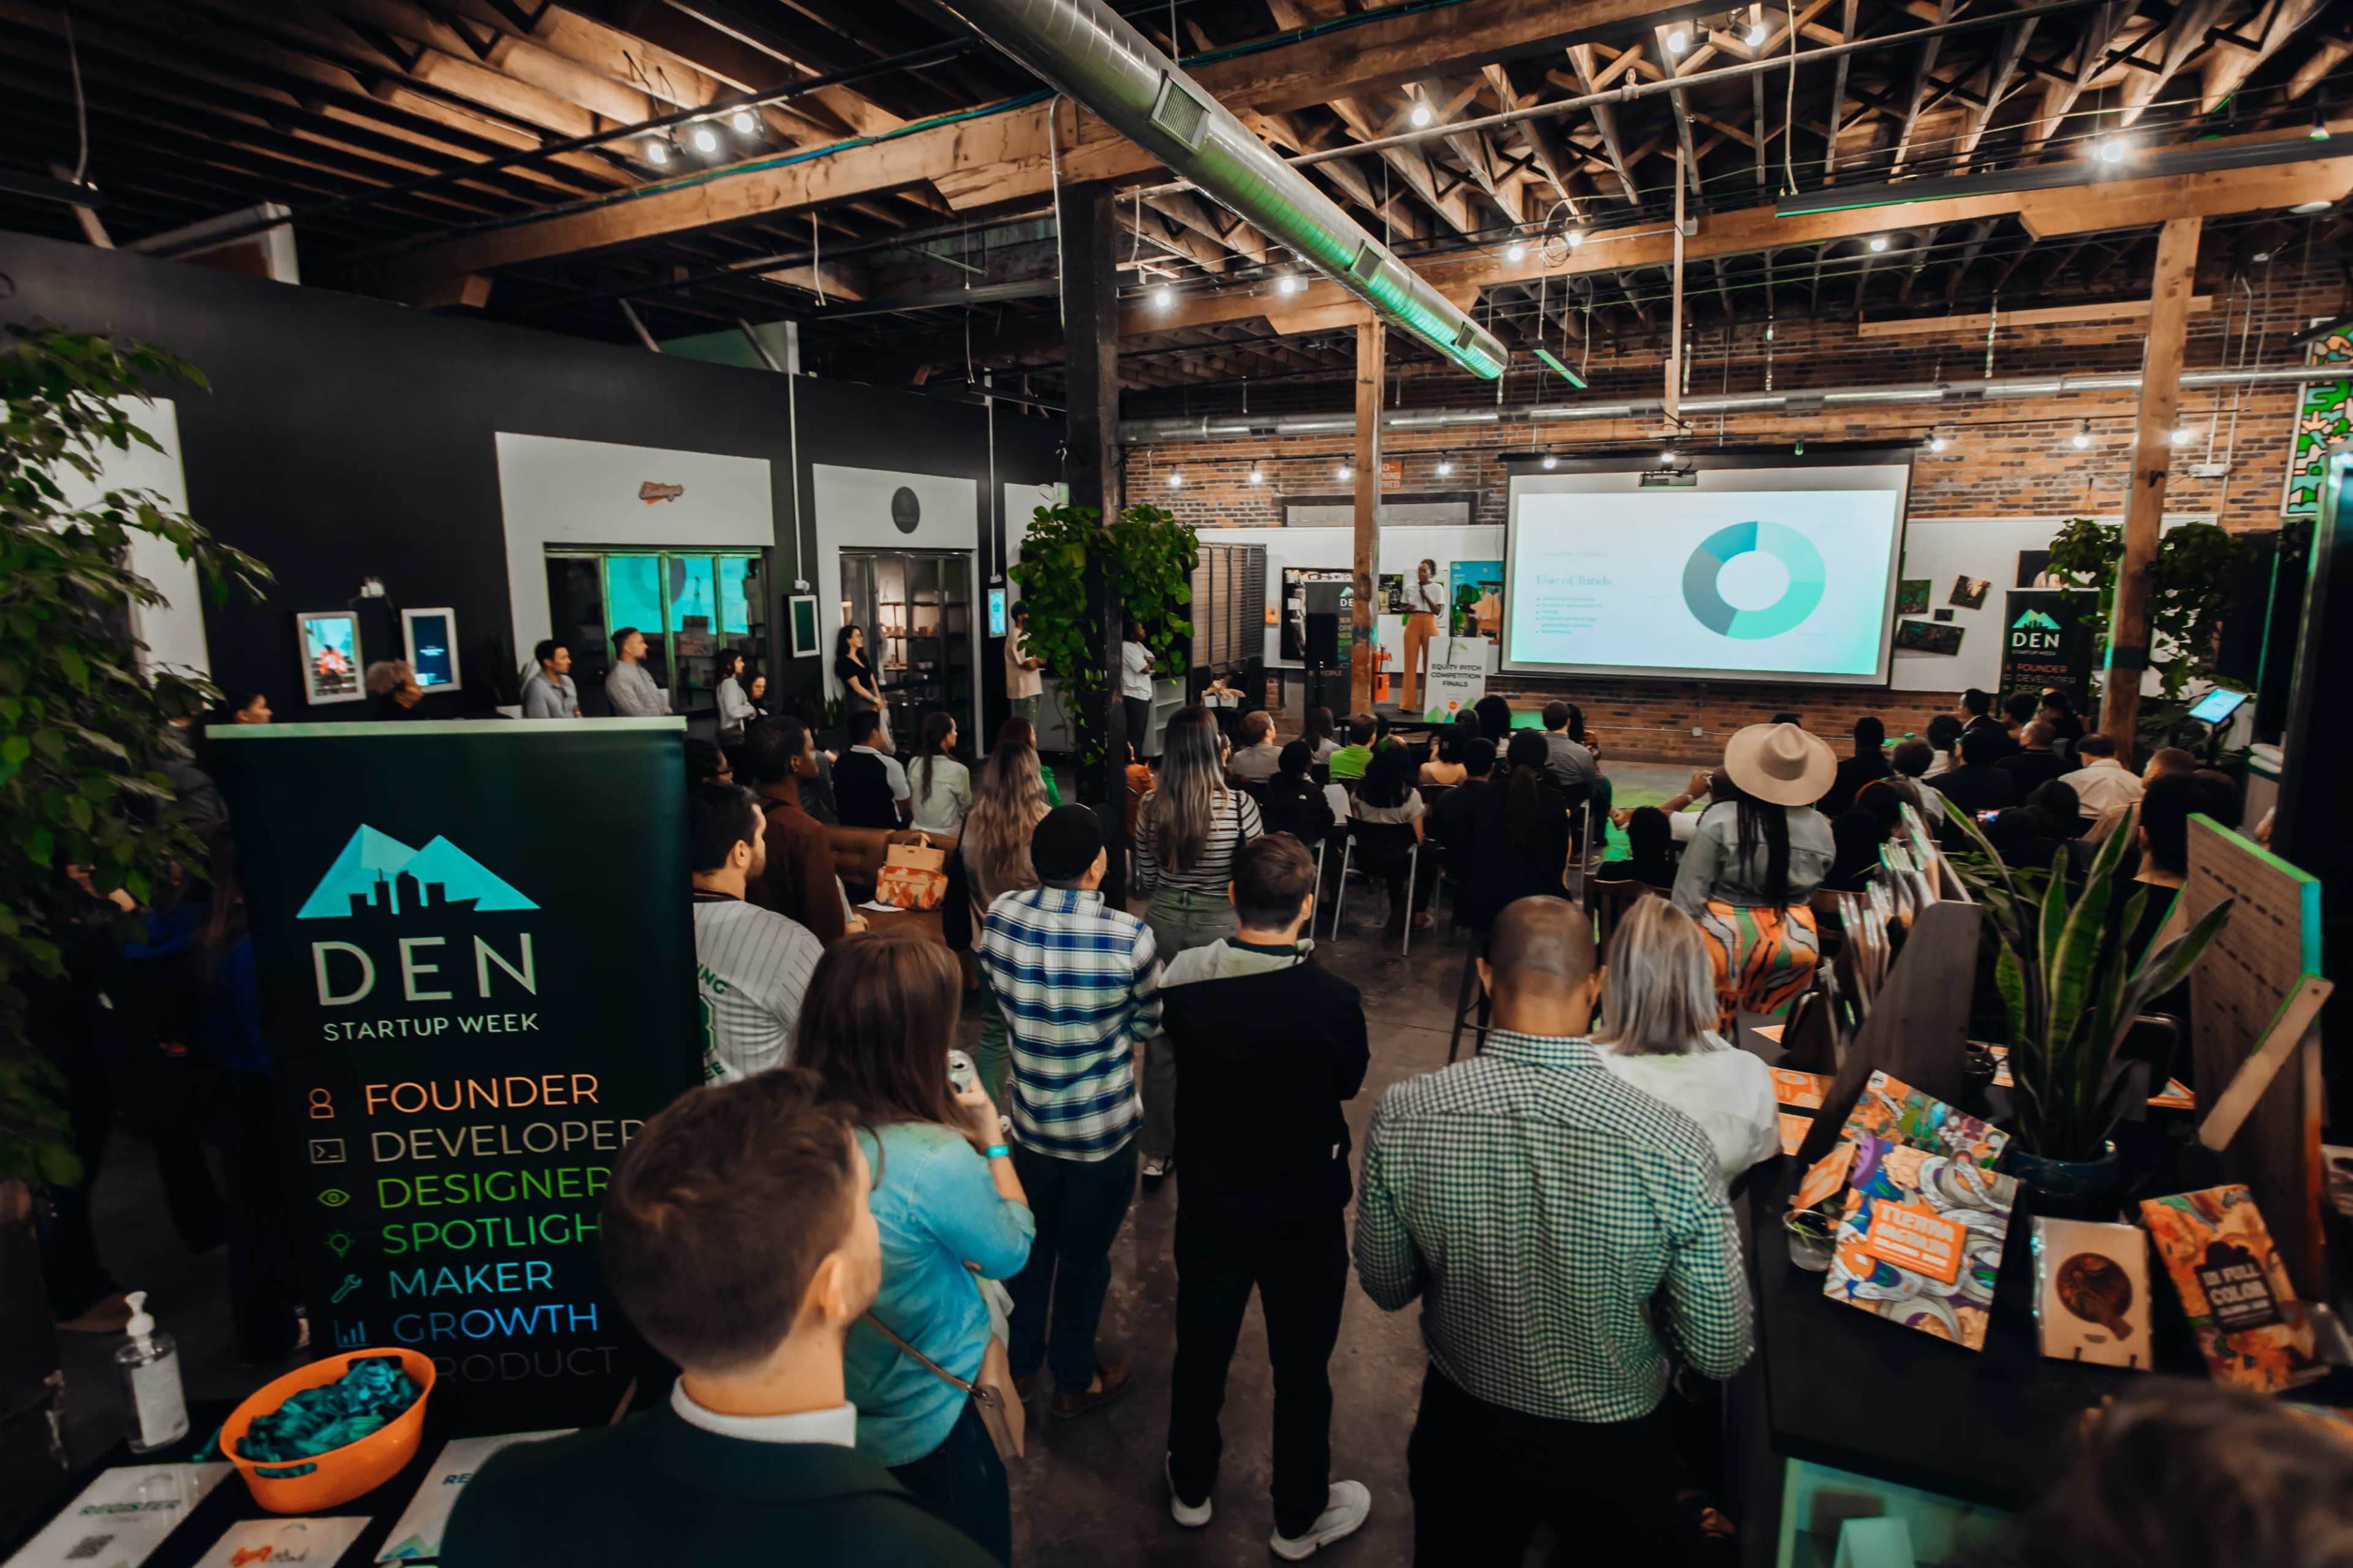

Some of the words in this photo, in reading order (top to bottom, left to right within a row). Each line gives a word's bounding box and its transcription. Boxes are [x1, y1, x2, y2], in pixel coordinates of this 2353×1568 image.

[1339, 599, 1353, 607] DE
[2012, 632, 2059, 648] DEN
[2017, 663, 2068, 673] FOUNDER
[311, 933, 537, 1006] DEN
[324, 1018, 449, 1041] STARTUP
[458, 1013, 539, 1034] WEEK
[365, 1074, 599, 1115] FOUNDER
[371, 1119, 645, 1162] DEVELOPER
[377, 1167, 612, 1208] DESIGNER
[382, 1213, 602, 1254] SPOTLIGH
[389, 1260, 554, 1300] MAKER
[2209, 1279, 2268, 1306] COLOR
[393, 1303, 598, 1343] GROWTH
[433, 1346, 618, 1382] RODUCT
